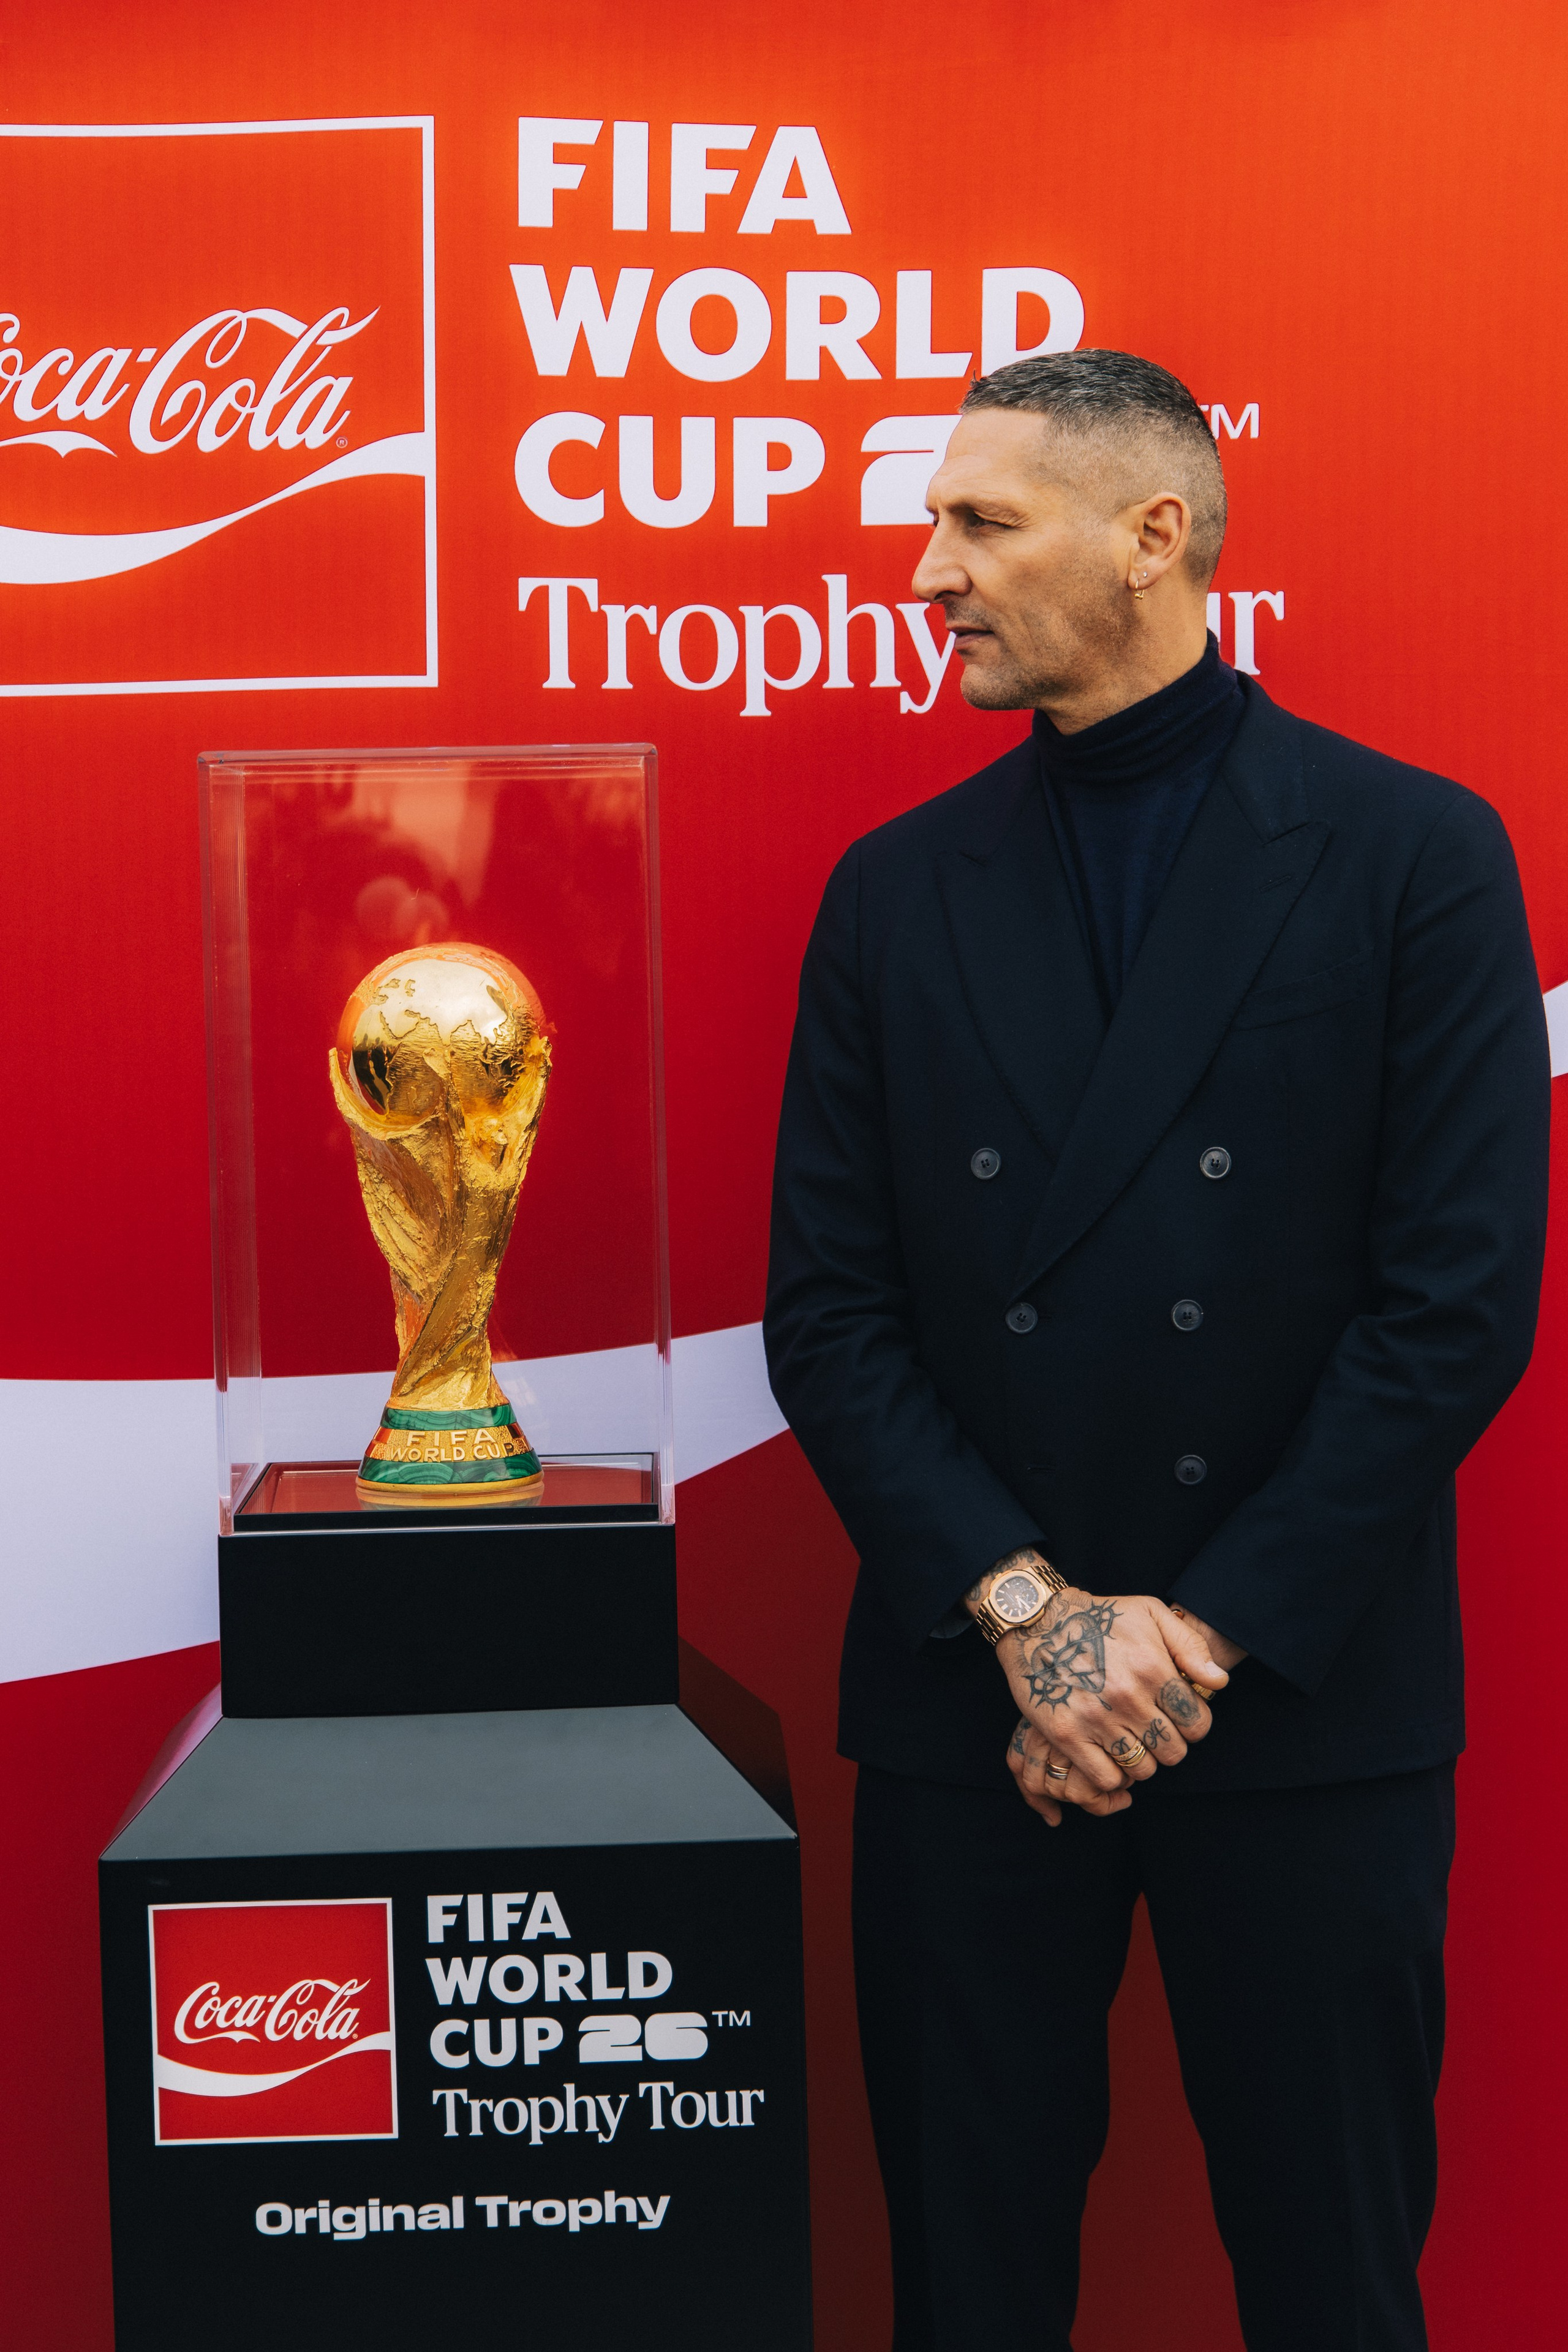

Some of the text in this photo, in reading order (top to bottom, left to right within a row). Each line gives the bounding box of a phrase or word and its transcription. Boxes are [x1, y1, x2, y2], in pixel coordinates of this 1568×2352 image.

[518, 116, 852, 235] FIFA
[509, 264, 1085, 382] WORLD
[514, 411, 826, 529] CUP
[861, 414, 963, 526] 2
[518, 574, 956, 717] Trophy
[390, 1442, 514, 1463] WORLD CUP
[406, 1428, 496, 1447] FIFA
[427, 1891, 571, 1943] FIFA
[425, 1951, 673, 2005] WORLD
[174, 1978, 371, 2044] Coca-Cola
[430, 2017, 564, 2068] CUP
[432, 2081, 764, 2145] Trophy Tour
[255, 2190, 671, 2240] Original Trophy
